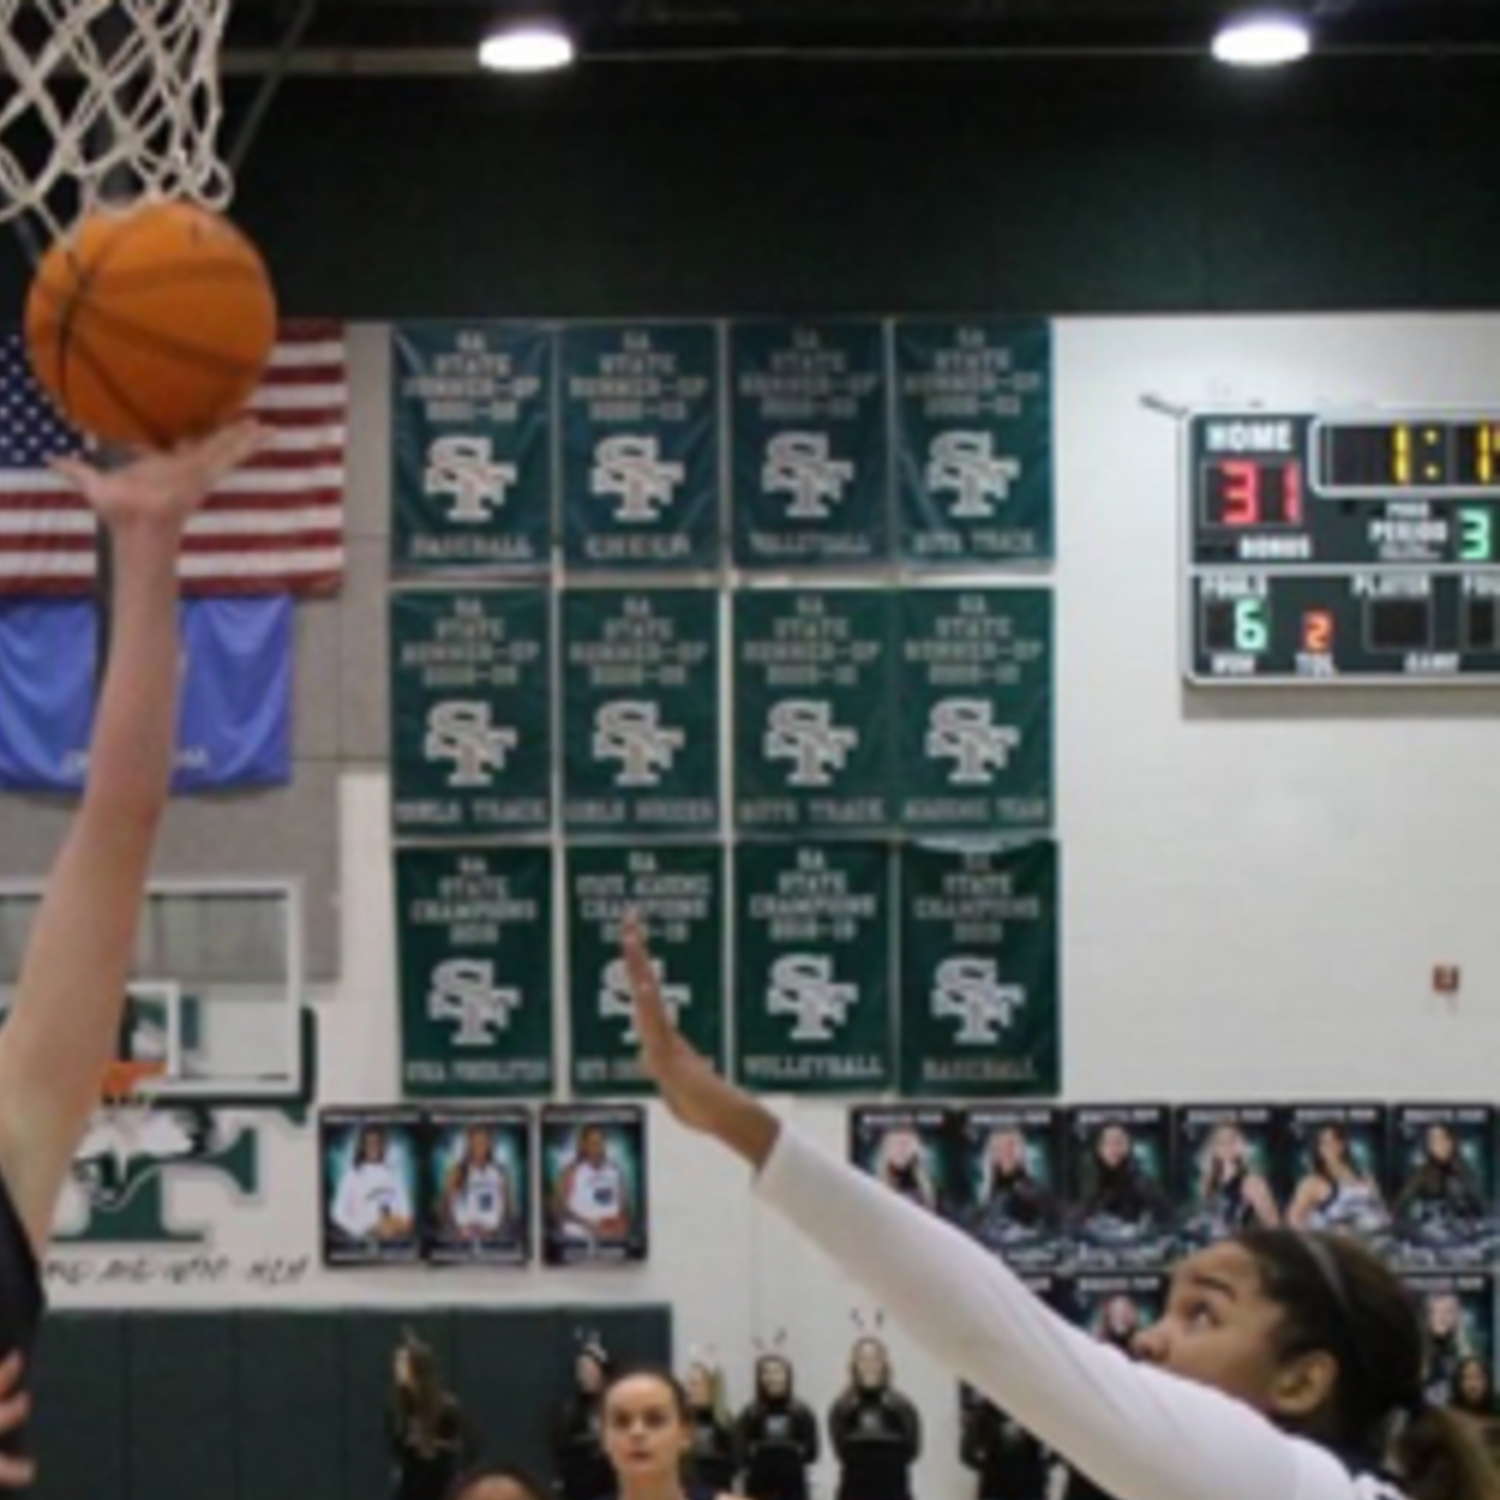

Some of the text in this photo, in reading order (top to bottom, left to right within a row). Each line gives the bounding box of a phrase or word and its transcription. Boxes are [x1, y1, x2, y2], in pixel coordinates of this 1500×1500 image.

[1205, 421, 1292, 451] HOME
[1218, 458, 1299, 526] 31
[1458, 508, 1491, 560] 3
[1233, 598, 1267, 651] 6
[1303, 611, 1332, 651] 2
